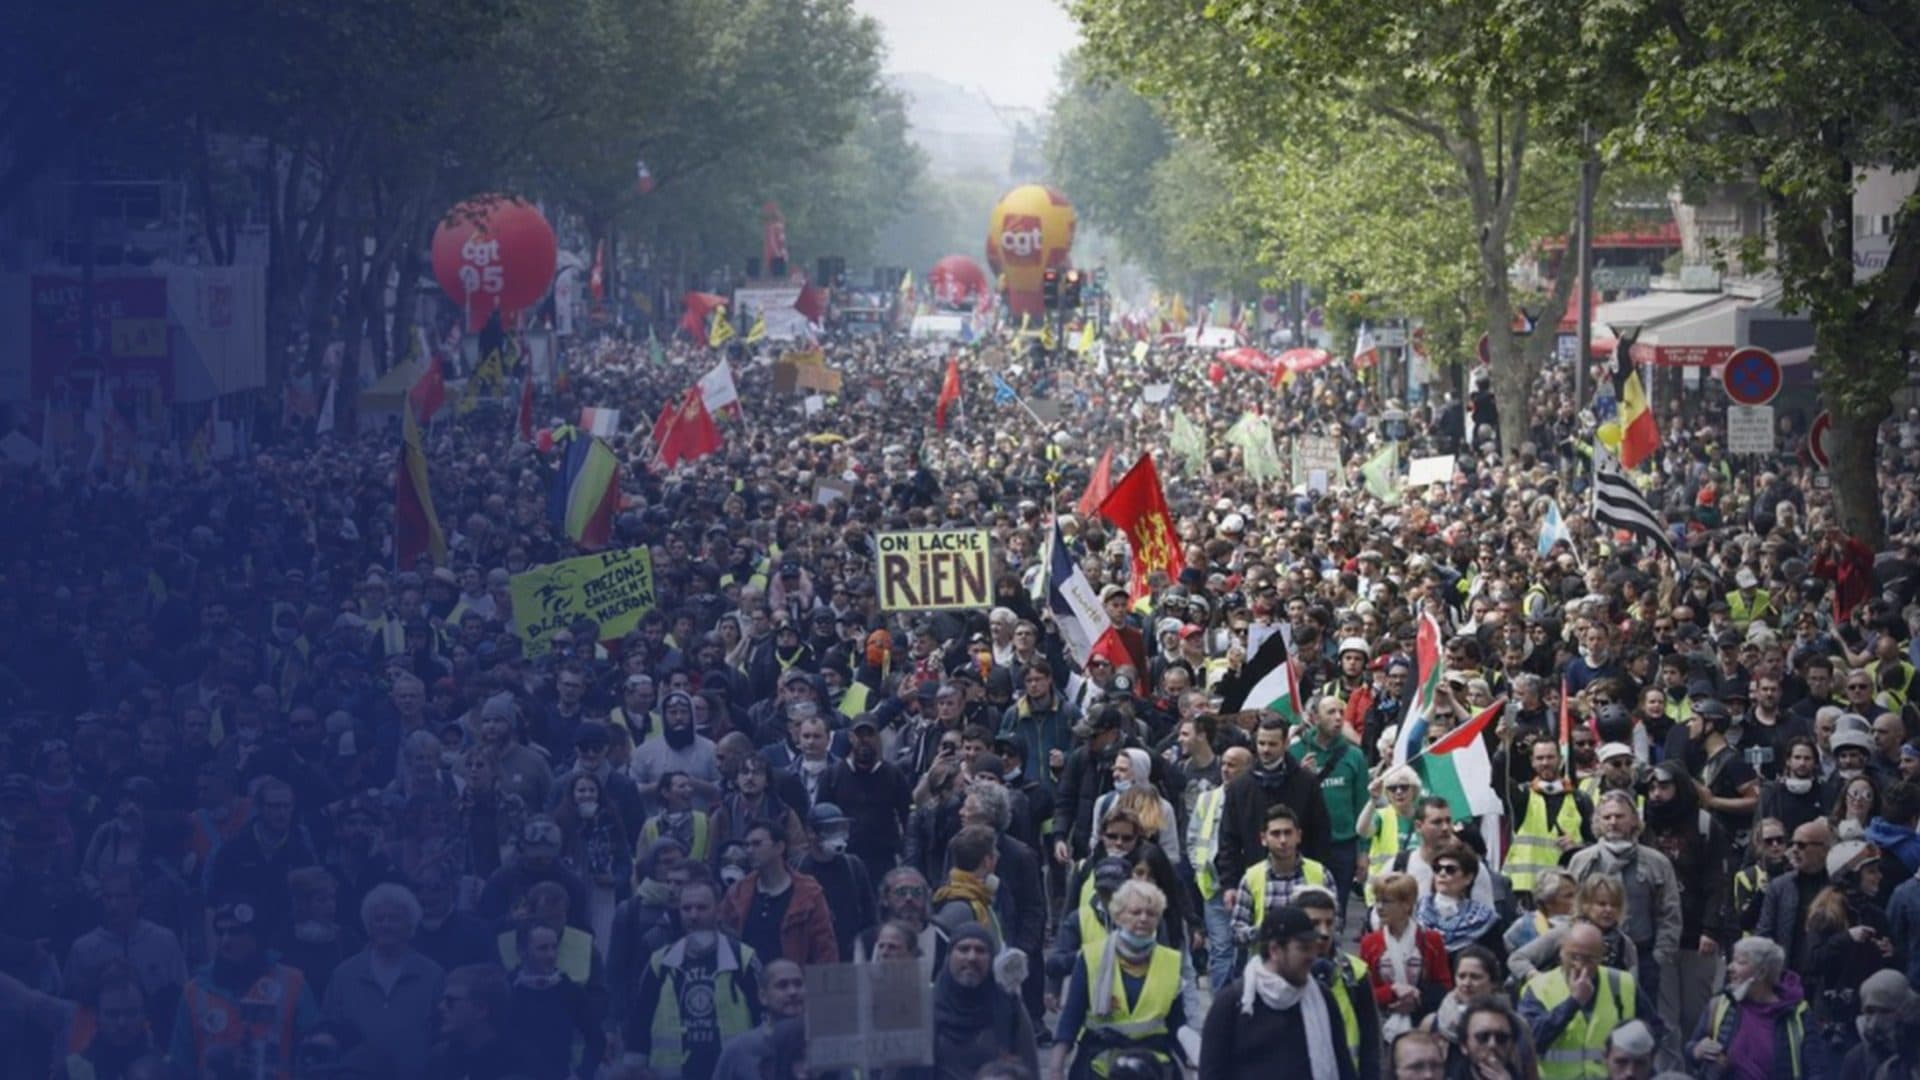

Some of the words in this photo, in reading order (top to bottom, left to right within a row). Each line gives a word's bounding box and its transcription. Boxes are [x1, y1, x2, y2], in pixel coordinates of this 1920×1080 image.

[461, 239, 500, 267] cgt
[1001, 226, 1042, 256] cgt
[880, 535, 909, 551] ON
[918, 533, 981, 551] LACHE
[596, 589, 654, 623] MACRON
